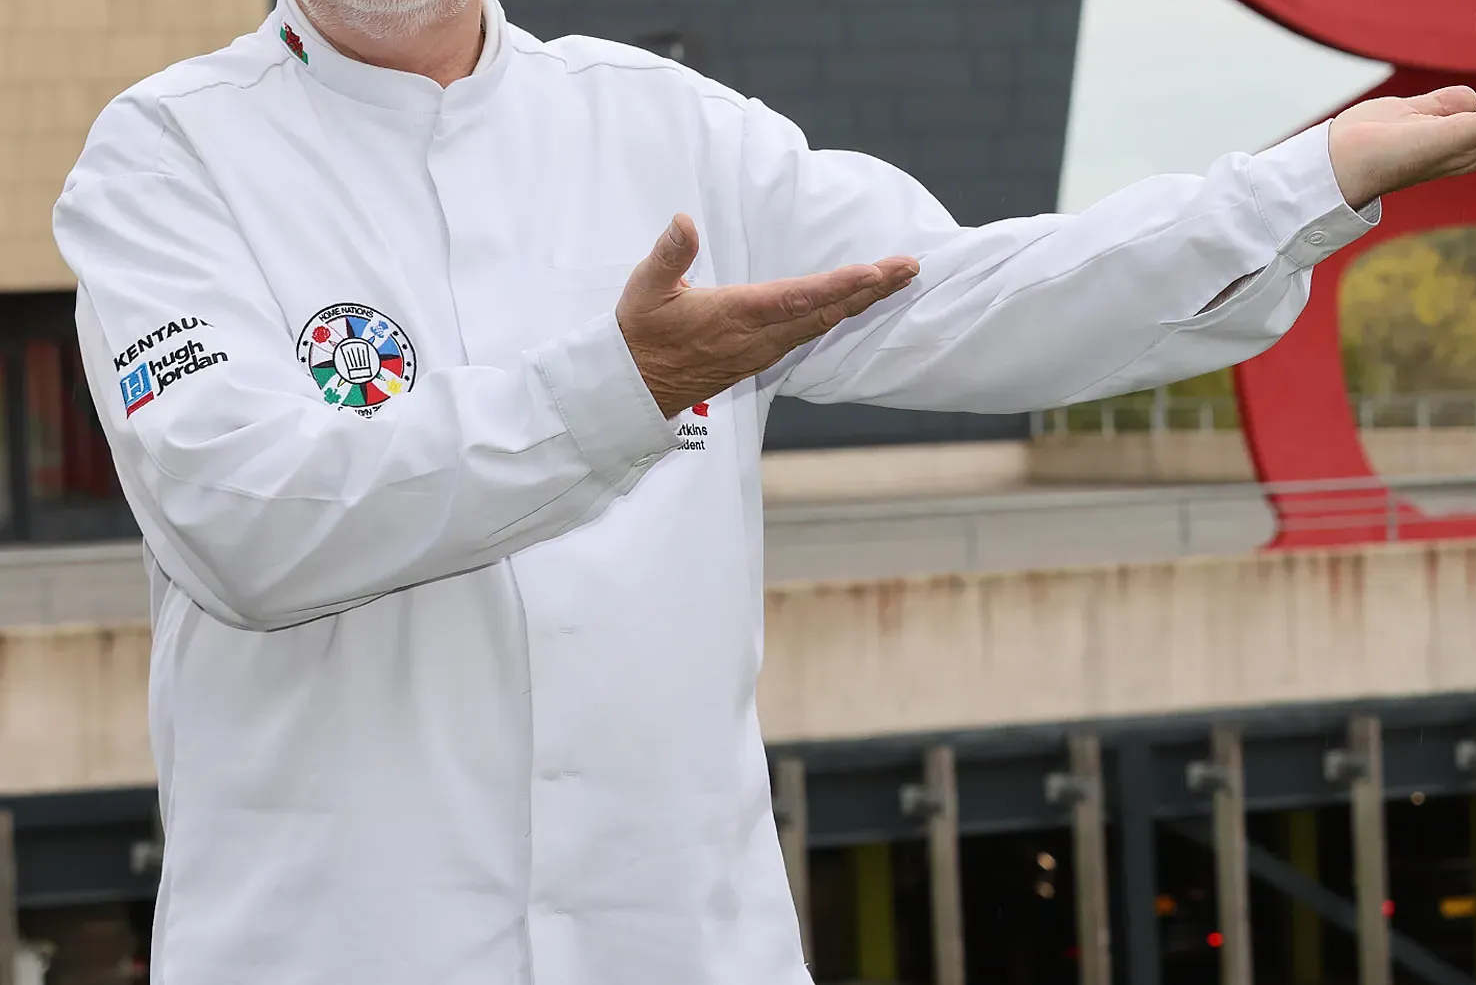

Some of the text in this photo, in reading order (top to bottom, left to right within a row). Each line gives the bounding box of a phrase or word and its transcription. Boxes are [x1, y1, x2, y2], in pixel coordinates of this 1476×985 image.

[318, 306, 374, 322] HOME NATIONS
[113, 317, 214, 372] KENTAU
[148, 340, 204, 376] hugh
[156, 352, 229, 397] jordan
